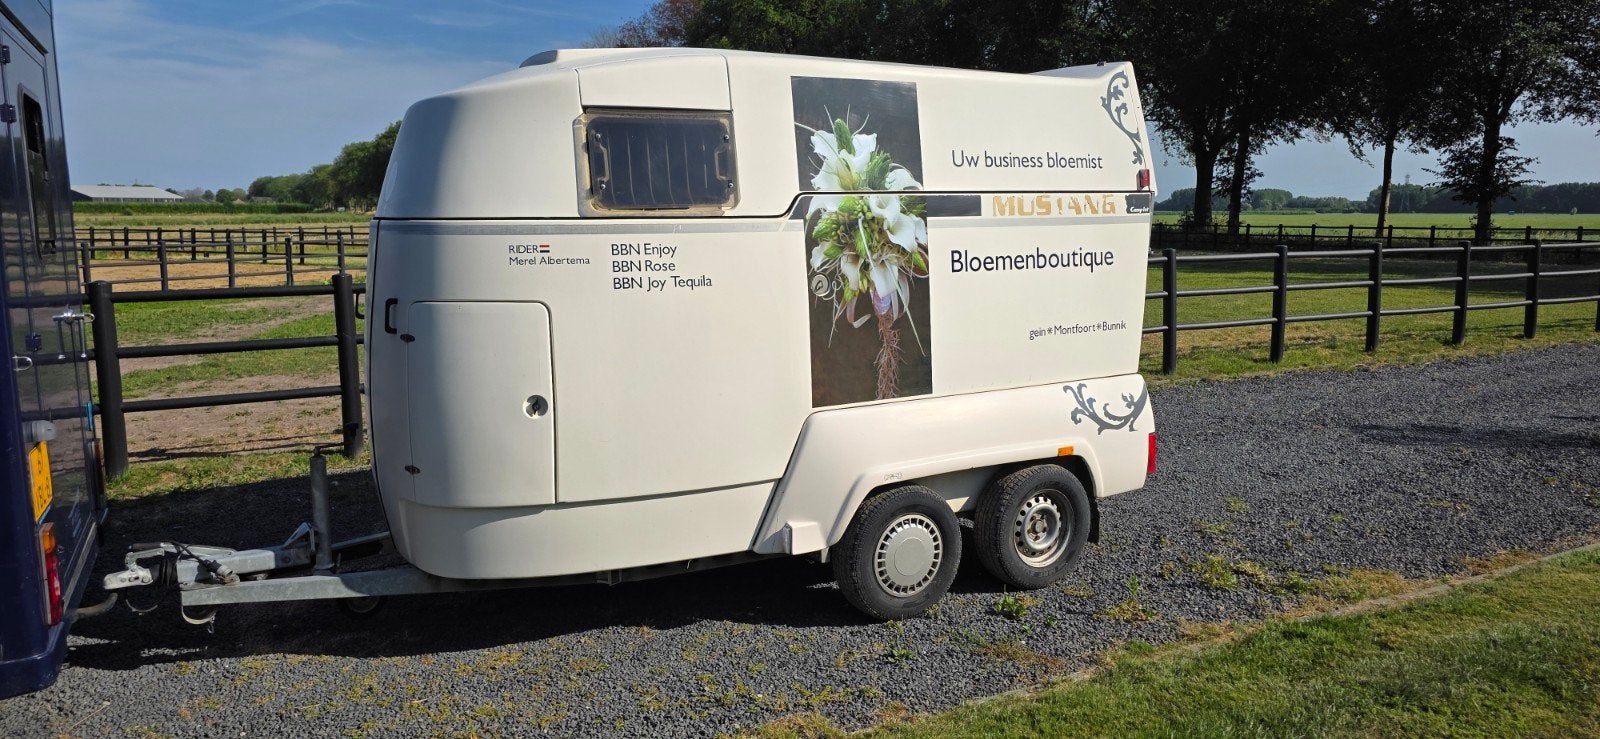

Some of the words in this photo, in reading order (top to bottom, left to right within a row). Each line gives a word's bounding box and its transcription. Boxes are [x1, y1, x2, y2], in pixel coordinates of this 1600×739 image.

[951, 149, 979, 168] Uw
[985, 151, 1043, 168] business
[1047, 152, 1104, 169] bloemist
[508, 245, 539, 254] RIDER
[611, 243, 641, 256] BBN
[644, 243, 677, 259] Enjoy
[508, 256, 537, 265] Merel
[539, 256, 590, 265] Albertema
[612, 260, 641, 273] BBN
[645, 260, 676, 272] Rose
[950, 247, 1114, 273] Bloemenboutique
[613, 277, 643, 290] BBN
[647, 277, 666, 292] Joy
[670, 275, 713, 291] Tequila
